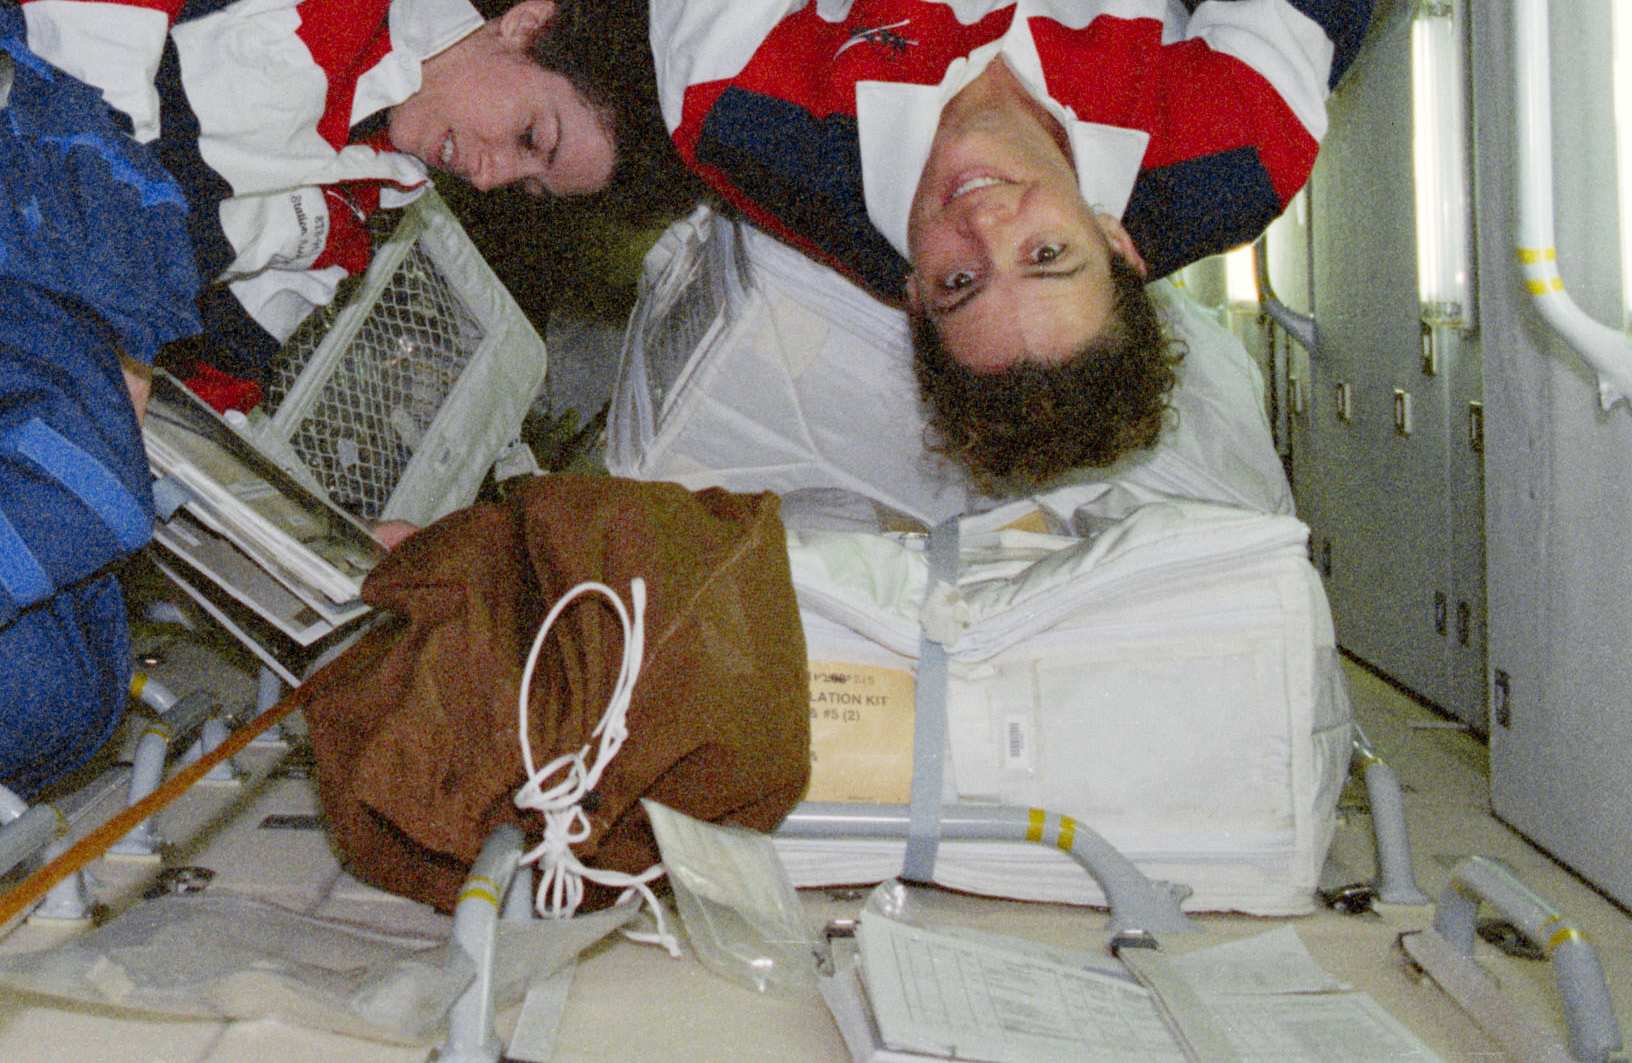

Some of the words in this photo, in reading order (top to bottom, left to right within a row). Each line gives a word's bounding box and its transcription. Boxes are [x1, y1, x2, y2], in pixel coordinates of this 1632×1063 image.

[291, 195, 308, 236] Station
[866, 695, 888, 707] KIT
[843, 710, 860, 723] (2)
